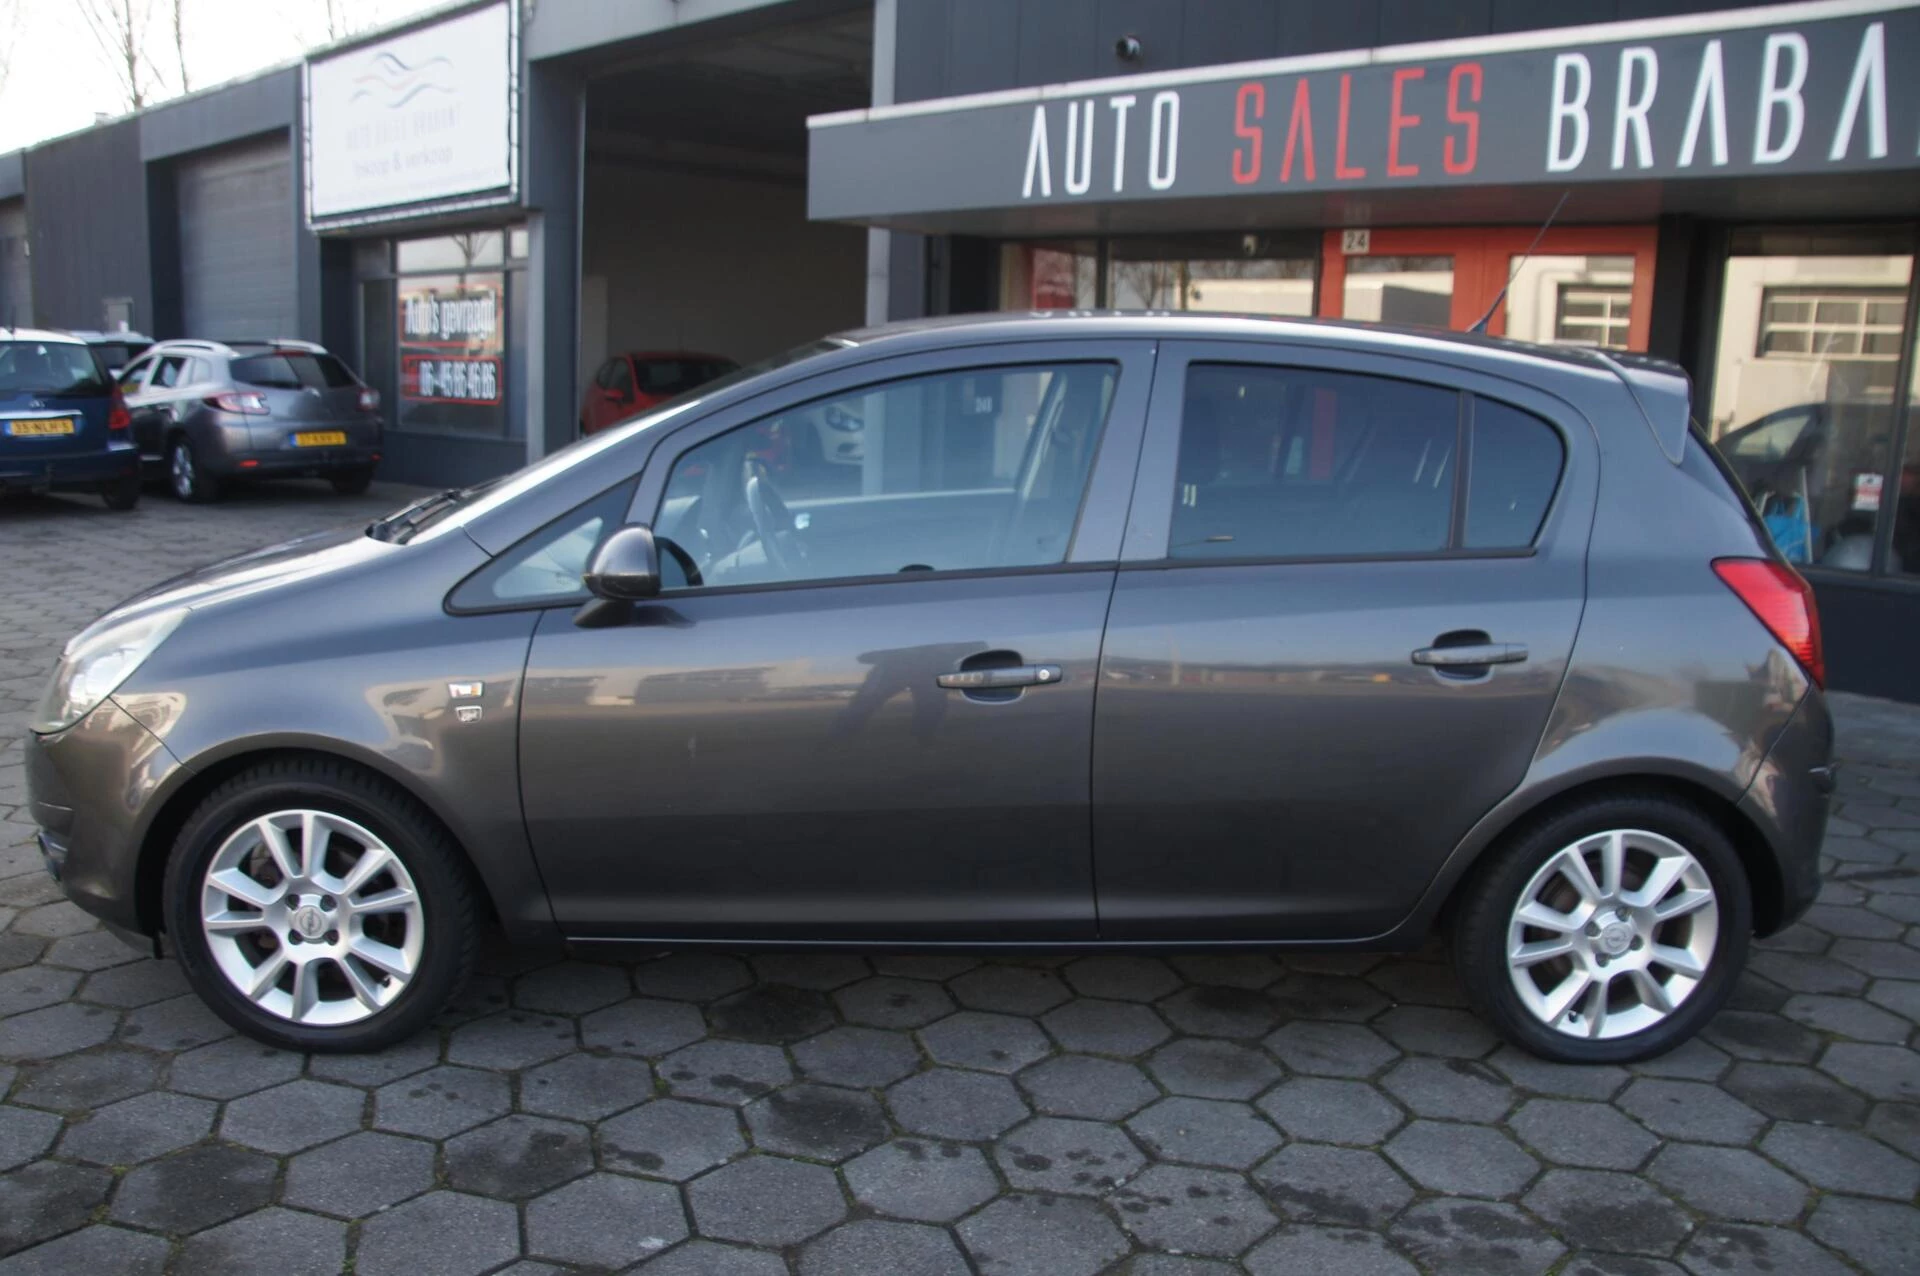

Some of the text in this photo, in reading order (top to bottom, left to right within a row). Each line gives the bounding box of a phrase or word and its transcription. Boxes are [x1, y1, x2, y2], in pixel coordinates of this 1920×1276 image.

[1022, 21, 1920, 198] AUTO SALES BRABA
[1346, 230, 1366, 249] 24
[440, 290, 496, 340] gevraagd
